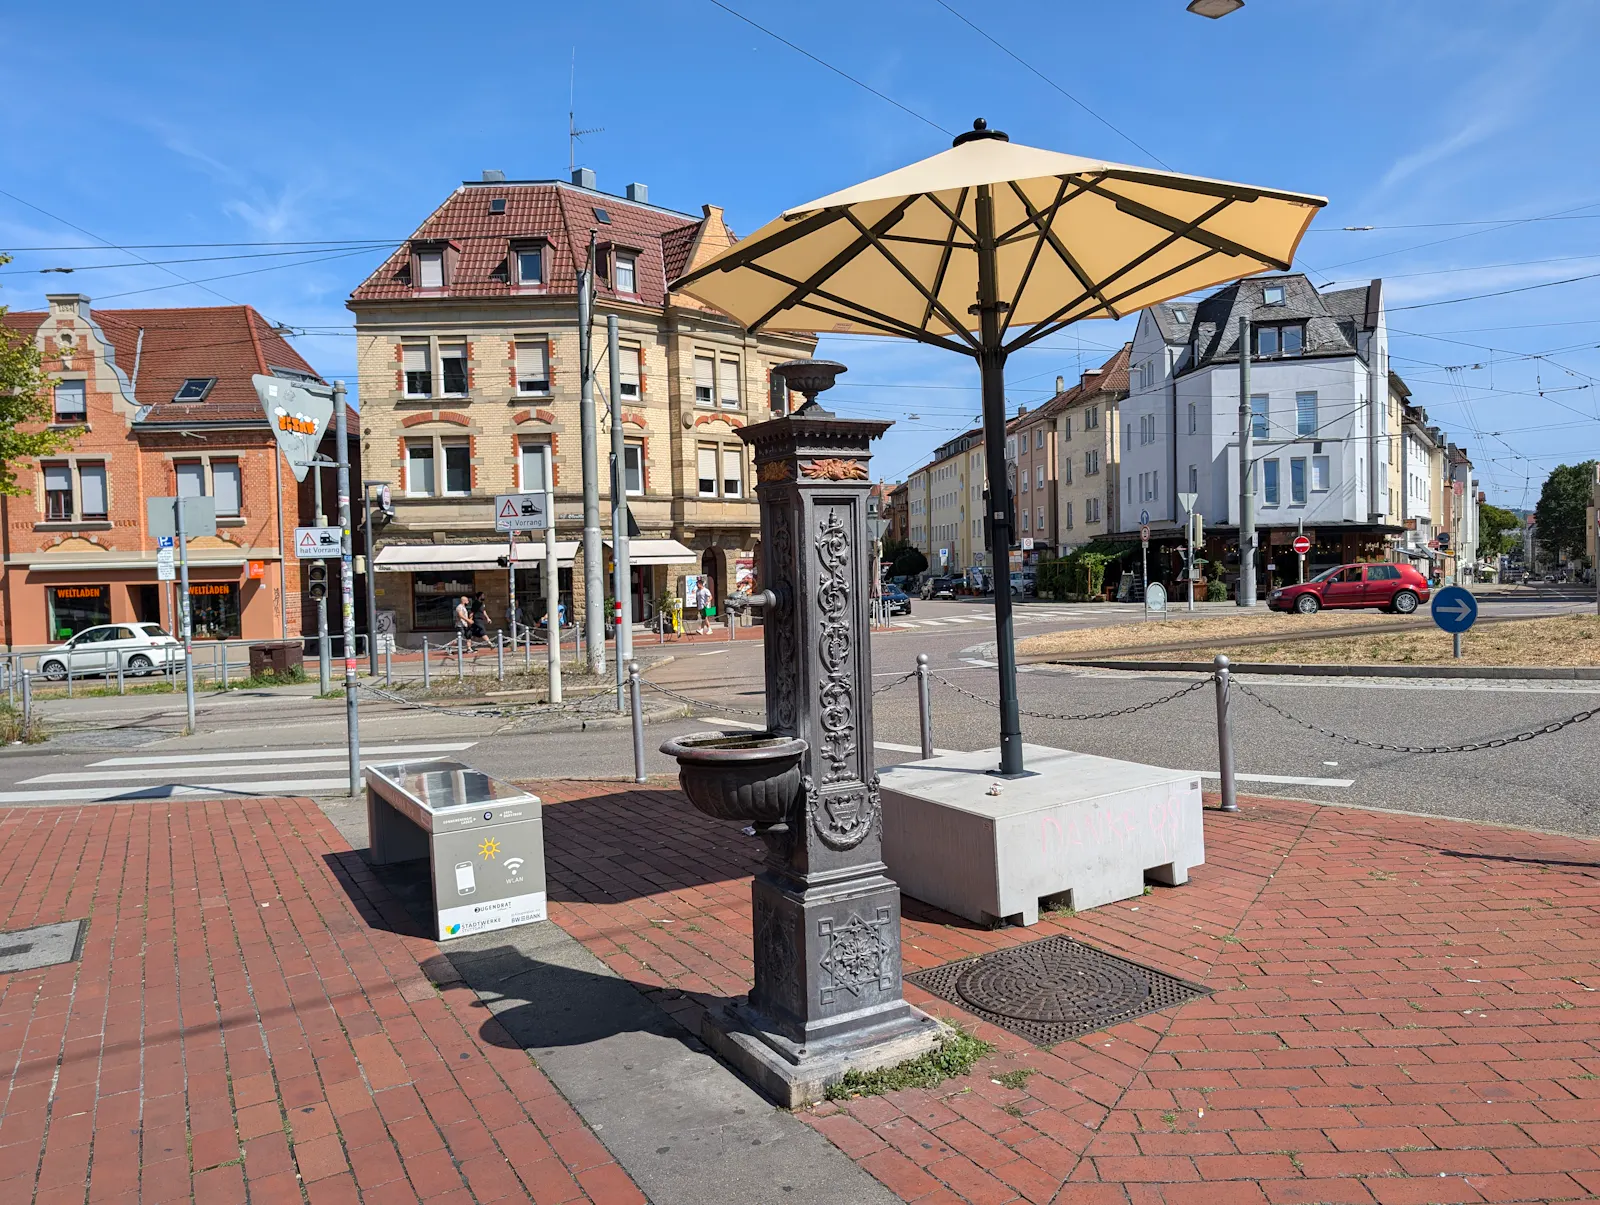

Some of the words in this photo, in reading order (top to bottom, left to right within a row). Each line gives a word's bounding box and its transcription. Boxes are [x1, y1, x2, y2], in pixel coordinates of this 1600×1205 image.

[515, 519, 542, 527] Vorrang
[159, 536, 168, 547] P
[57, 588, 100, 598] WELTLADEN
[188, 585, 230, 595] WELTLADEN
[505, 876, 524, 884] WLAN
[525, 912, 541, 921] BANK
[461, 917, 501, 929] STADTWERKE
